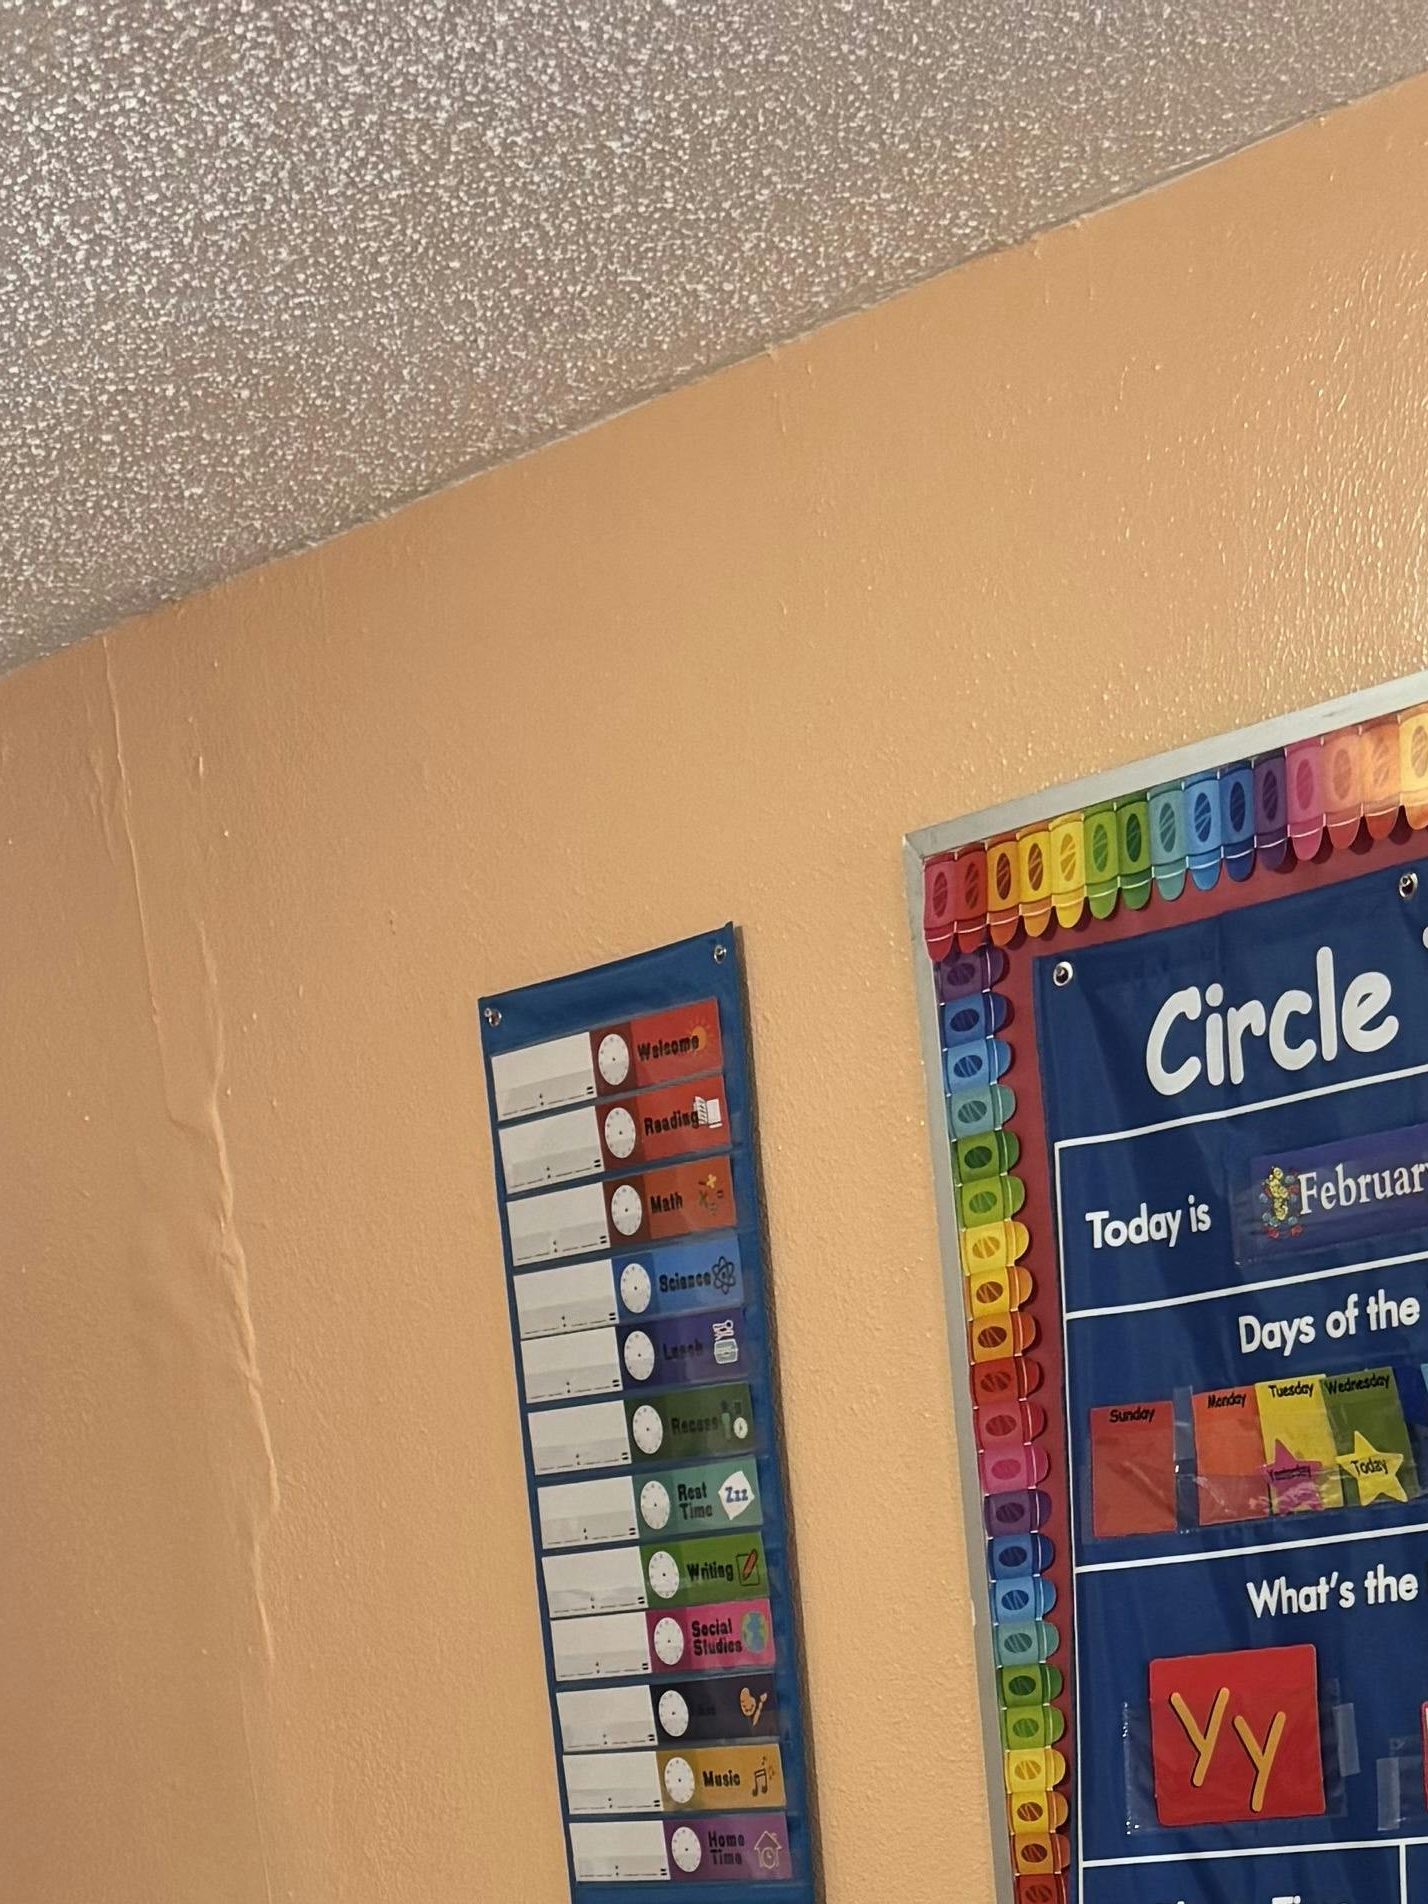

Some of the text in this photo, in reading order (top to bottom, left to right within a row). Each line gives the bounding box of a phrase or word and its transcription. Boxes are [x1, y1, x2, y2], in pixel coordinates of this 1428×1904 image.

[1146, 946, 1400, 1096] Circle
[637, 1035, 700, 1061] Welcome
[644, 1110, 699, 1135] Reading
[650, 1193, 683, 1214] Math
[1085, 1202, 1182, 1249] Today
[1188, 1194, 1212, 1233] is
[659, 1272, 711, 1292] Science
[1238, 1315, 1316, 1357] Days
[1325, 1293, 1359, 1339] of
[1366, 1288, 1421, 1331] the
[1268, 1382, 1314, 1398] Tuesday
[1324, 1374, 1390, 1395] Wednesday
[1109, 1407, 1155, 1423] Sunday
[1351, 1458, 1388, 1475] Today
[677, 1482, 707, 1501] Rest
[679, 1504, 713, 1520] Time
[687, 1562, 734, 1582] Writing
[1246, 1571, 1356, 1618] What's
[1364, 1563, 1419, 1605] the
[691, 1619, 732, 1638] Social
[693, 1638, 742, 1656] Studies
[1169, 1686, 1286, 1814] Yy
[703, 1770, 741, 1787] Music
[708, 1831, 745, 1847] Home
[710, 1848, 743, 1864] Time
